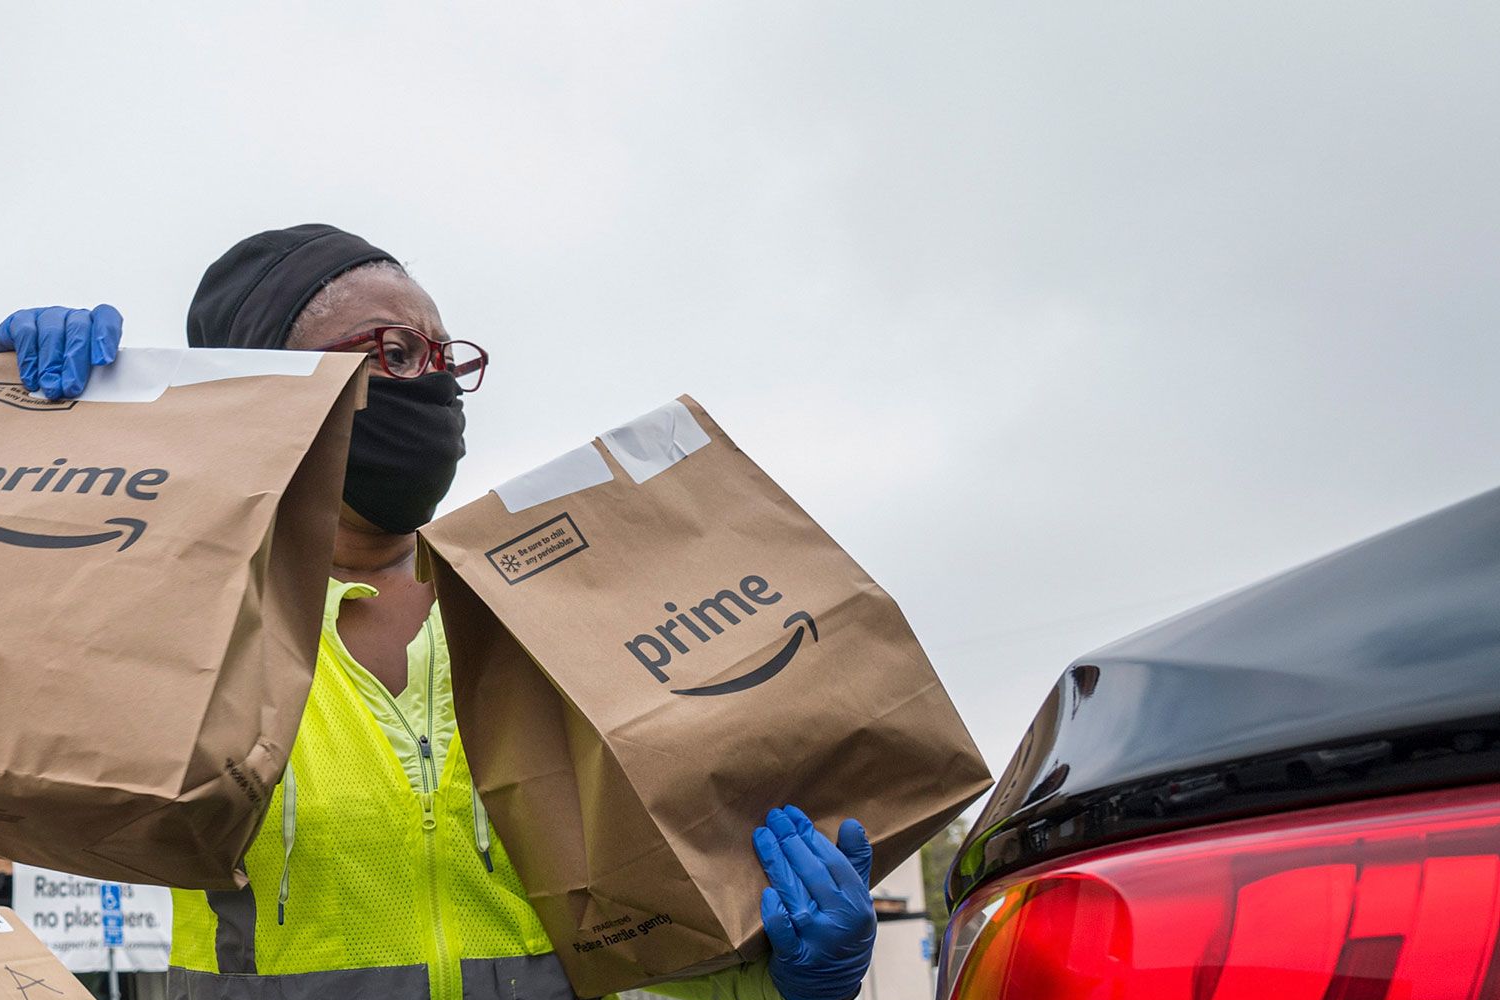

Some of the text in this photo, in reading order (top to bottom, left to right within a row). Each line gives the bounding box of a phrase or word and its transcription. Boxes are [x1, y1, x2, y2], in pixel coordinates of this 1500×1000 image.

[517, 528, 566, 557] Be sure to chill
[525, 537, 574, 566] any perishables
[624, 574, 783, 684] prime
[34, 911, 59, 928] no
[65, 905, 100, 933] plac
[637, 913, 673, 935] gently
